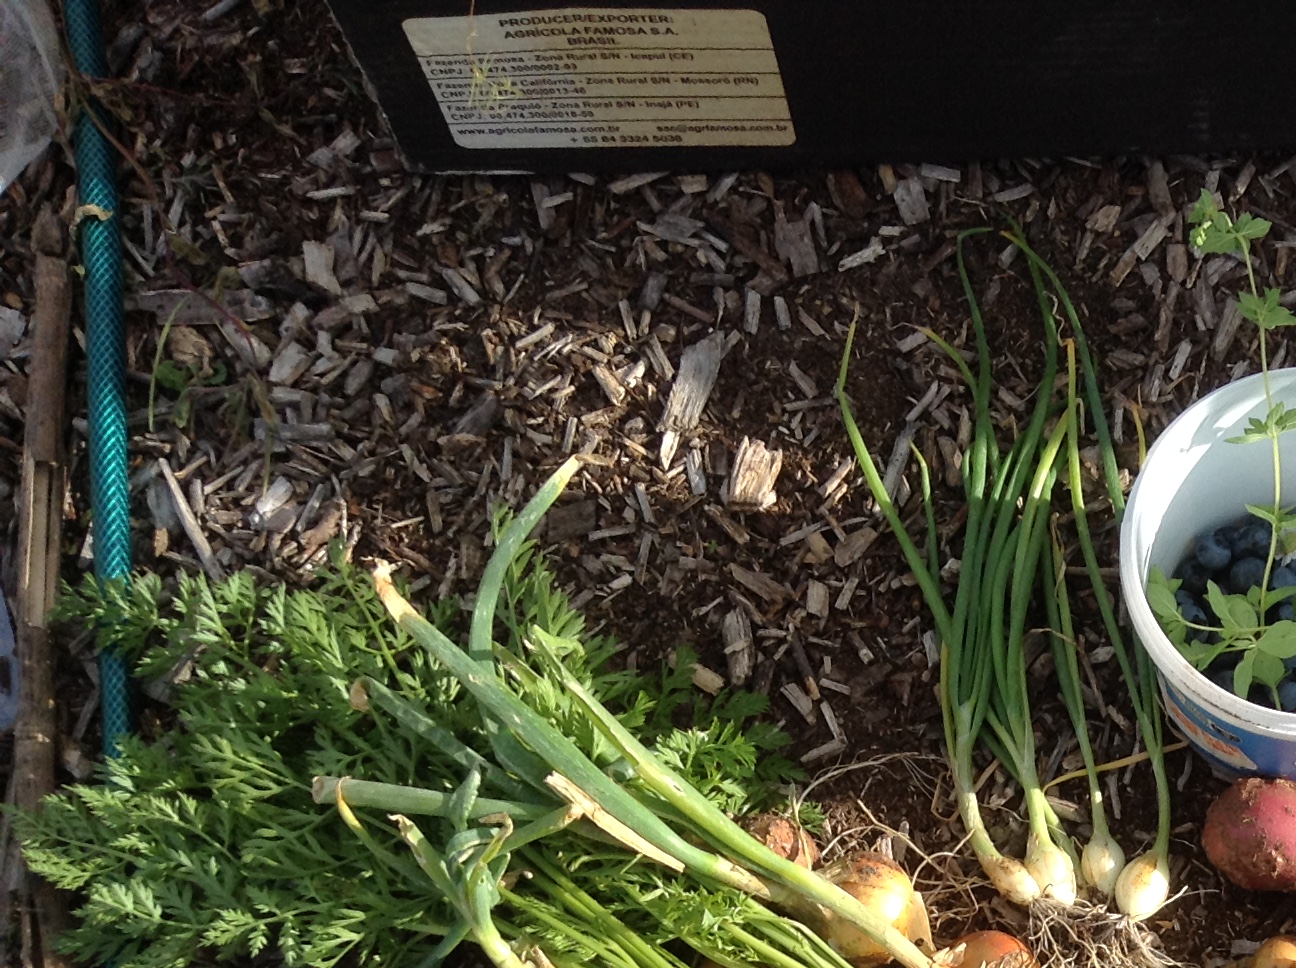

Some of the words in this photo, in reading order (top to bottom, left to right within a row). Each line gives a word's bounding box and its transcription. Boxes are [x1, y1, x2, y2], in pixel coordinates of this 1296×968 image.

[499, 14, 674, 27] PRODUCER/EXPORTER:
[505, 27, 581, 38] AGRÍCOLA
[584, 26, 647, 35] FAMOSA
[650, 27, 679, 35] S.A.
[567, 37, 619, 45] BRASIL
[668, 52, 694, 61] (CE)
[586, 77, 615, 85] Zona
[734, 77, 759, 86] (RN)
[551, 101, 581, 109] Zona
[582, 101, 613, 109] Rural
[616, 101, 636, 109] S/N
[675, 101, 700, 109] (PE)
